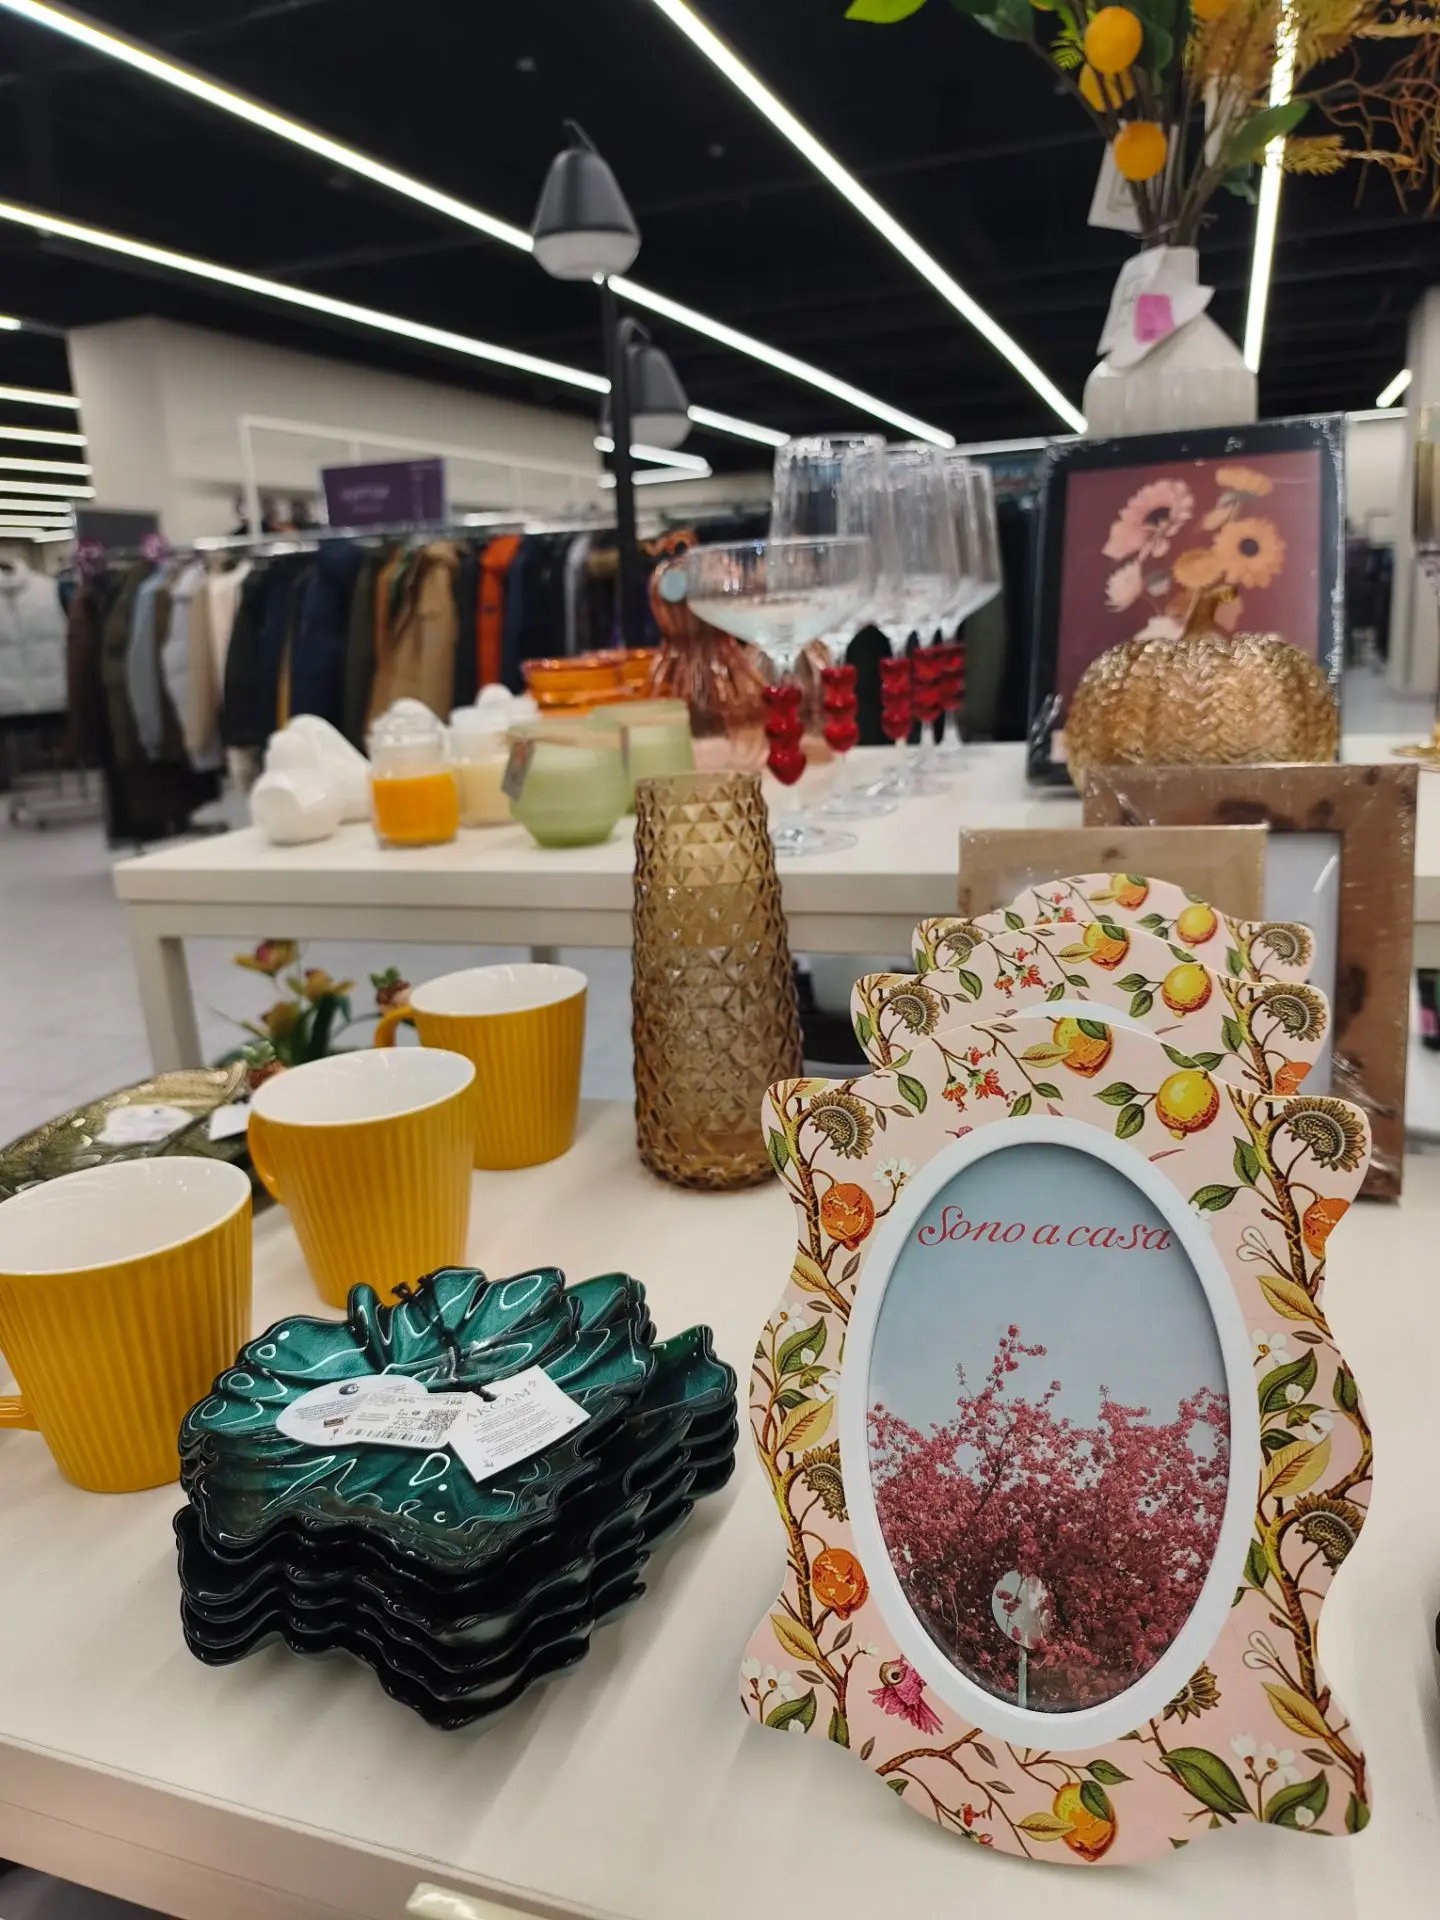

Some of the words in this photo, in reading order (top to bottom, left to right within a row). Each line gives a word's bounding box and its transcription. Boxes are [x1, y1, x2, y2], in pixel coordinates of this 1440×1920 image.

[917, 1205, 1027, 1247] Sono
[1032, 1224, 1061, 1245] a
[1066, 1223, 1172, 1251] casa
